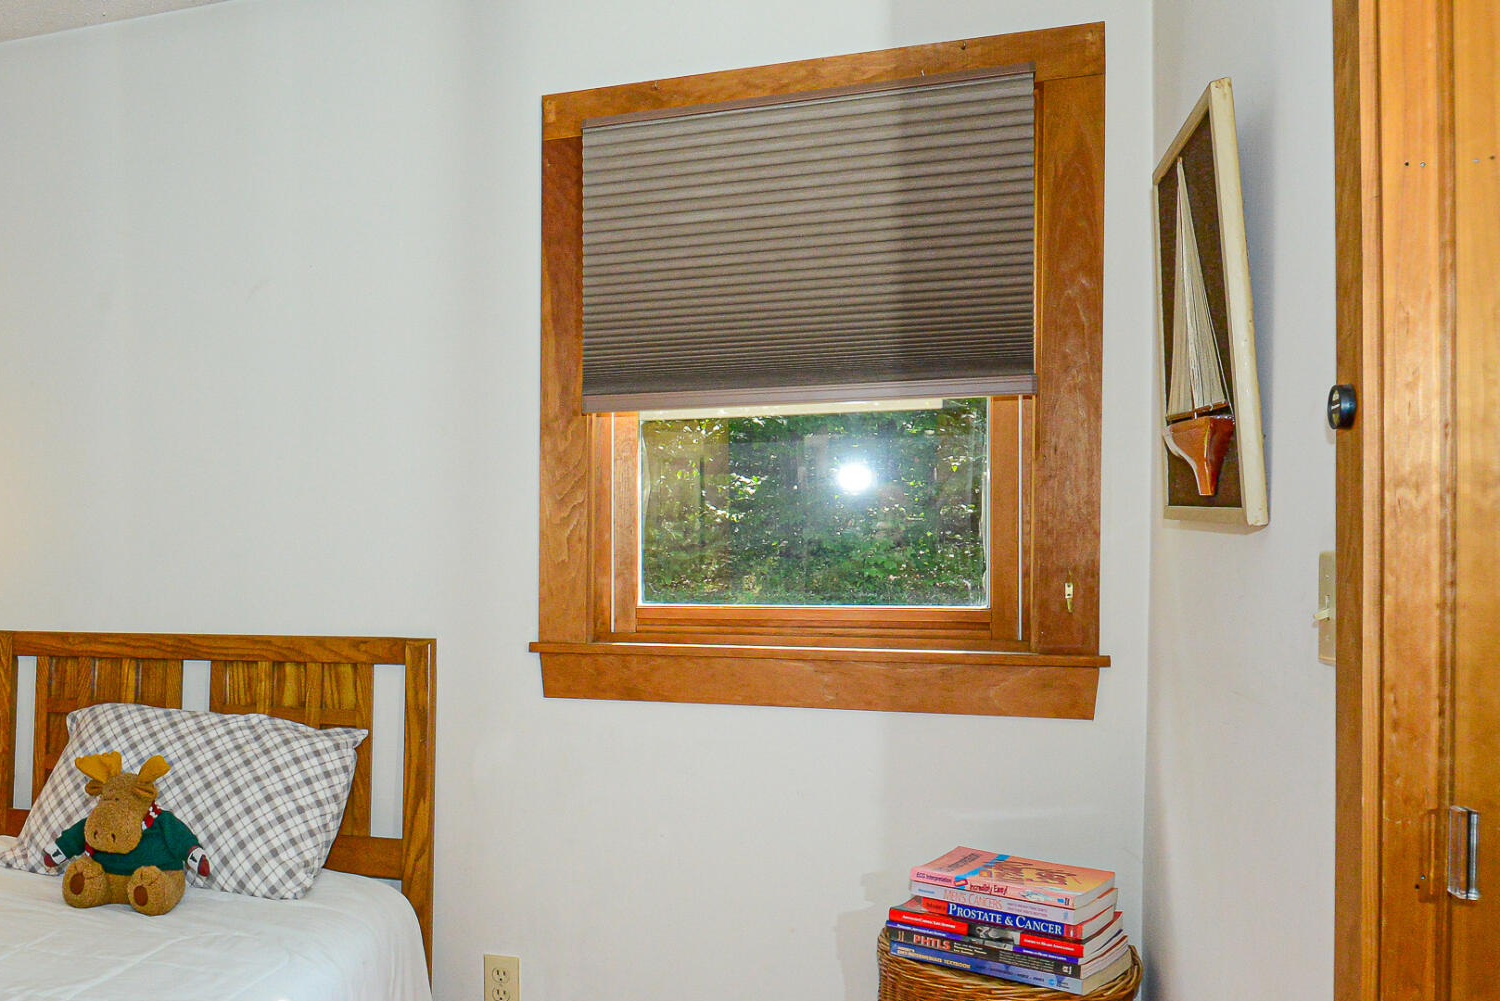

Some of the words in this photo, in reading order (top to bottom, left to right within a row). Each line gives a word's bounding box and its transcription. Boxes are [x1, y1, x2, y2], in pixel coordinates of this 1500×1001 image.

[916, 871, 926, 879] ECG
[926, 873, 952, 883] Interpretation
[969, 882, 993, 894] Incredibly
[993, 884, 1008, 895] Easy!
[943, 888, 967, 903] MEN'S
[968, 892, 1003, 910] CANCERS
[948, 903, 1002, 924] PROSTATE
[1004, 916, 1014, 926] &
[1015, 916, 1062, 936] CANCER
[913, 933, 951, 951] PHTLS
